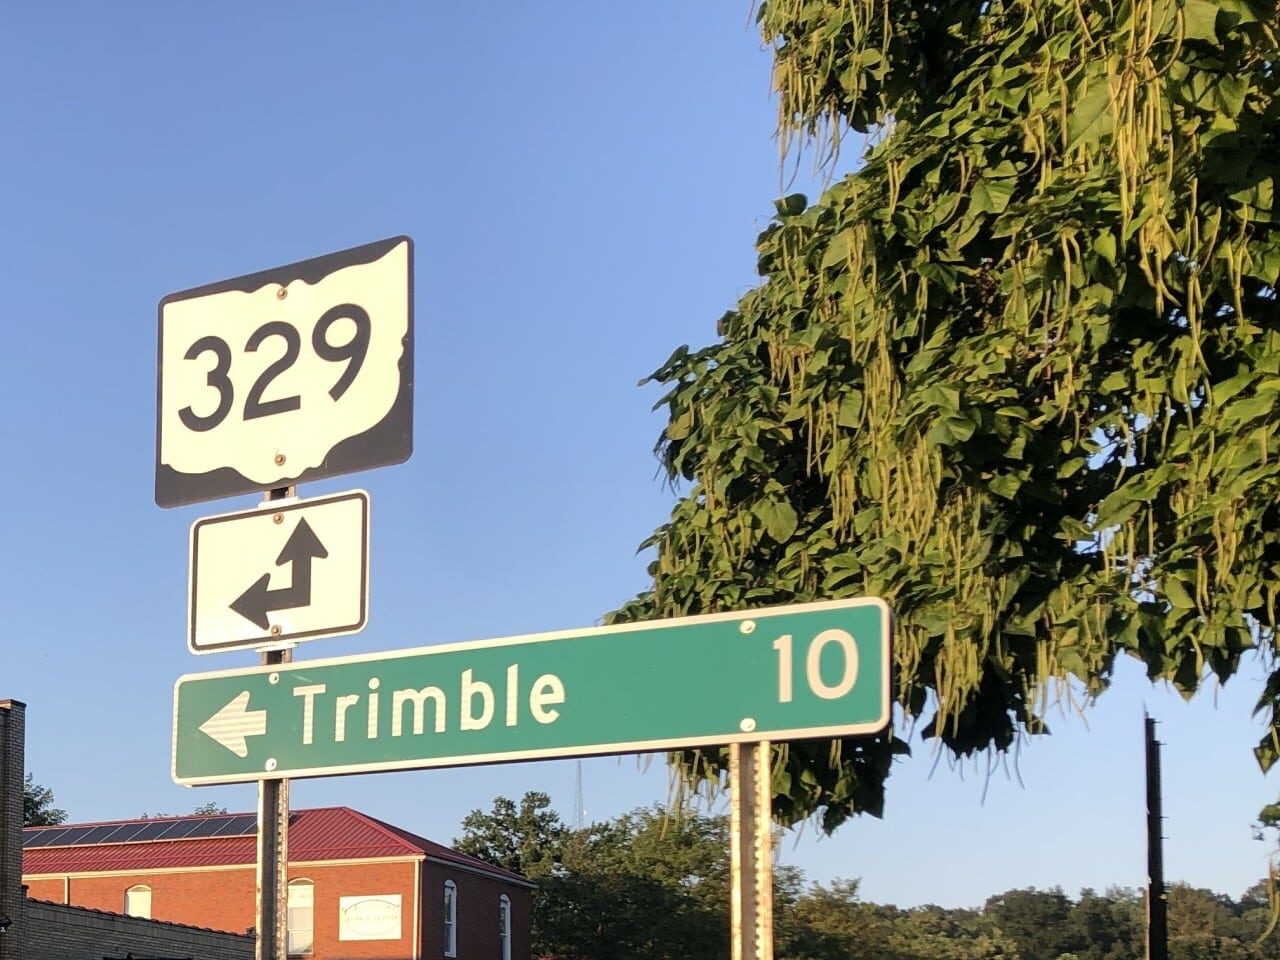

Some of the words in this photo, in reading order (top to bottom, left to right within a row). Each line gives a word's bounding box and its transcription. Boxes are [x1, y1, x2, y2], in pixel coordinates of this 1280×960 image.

[178, 303, 371, 432] 329
[293, 663, 565, 745] Trimble
[773, 629, 859, 703] 10
